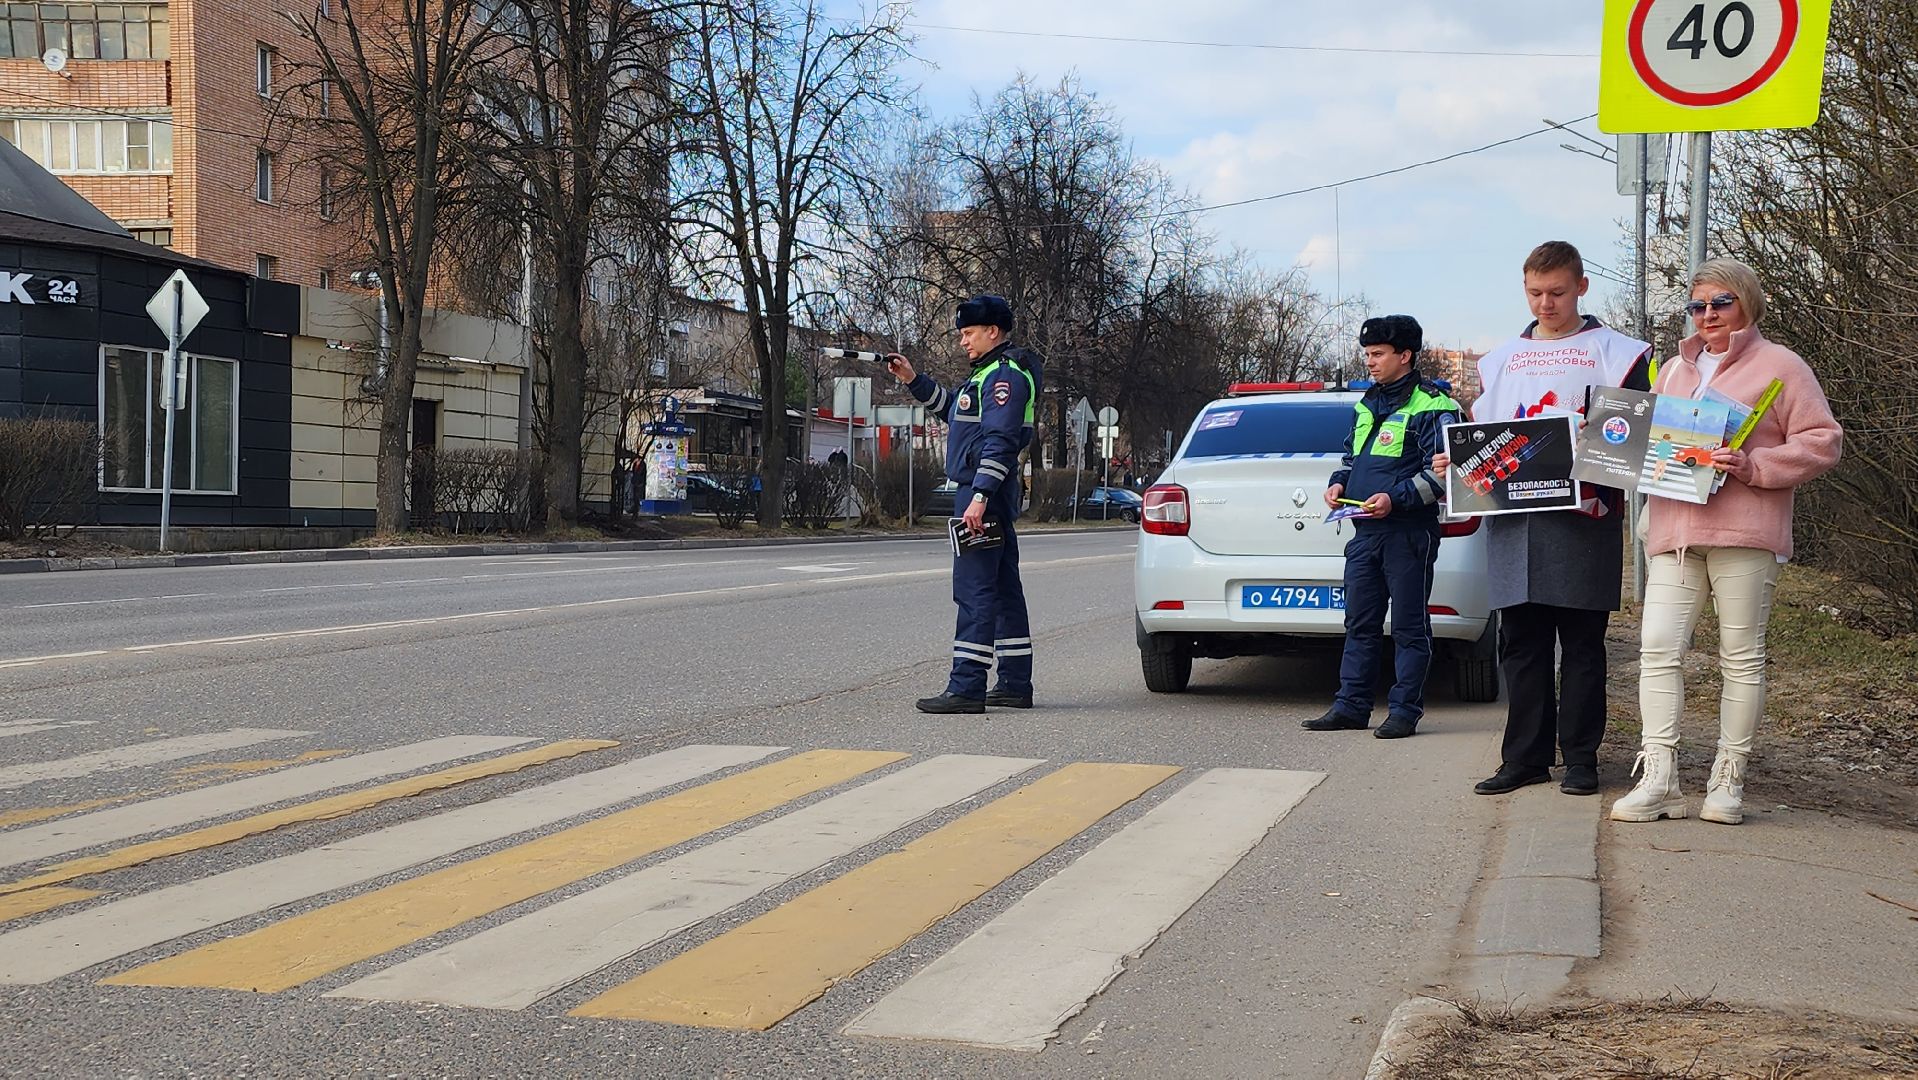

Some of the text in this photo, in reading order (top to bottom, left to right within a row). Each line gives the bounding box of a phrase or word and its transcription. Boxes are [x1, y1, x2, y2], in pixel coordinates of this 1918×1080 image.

[1667, 1, 1754, 60] 40
[48, 279, 78, 296] 24
[50, 295, 76, 304] ЧАСА
[1512, 348, 1588, 362] ВОЛОНТЕРЫ
[1505, 357, 1596, 376] ПОДМОСКОВЬЯ
[1456, 427, 1516, 478] ОДИН ЩЕЛЧОК
[1496, 433, 1529, 462] ЖИЗНЬ
[1507, 479, 1570, 491] БЕЗОПАСНОСТЬ
[1270, 588, 1320, 606] 4794
